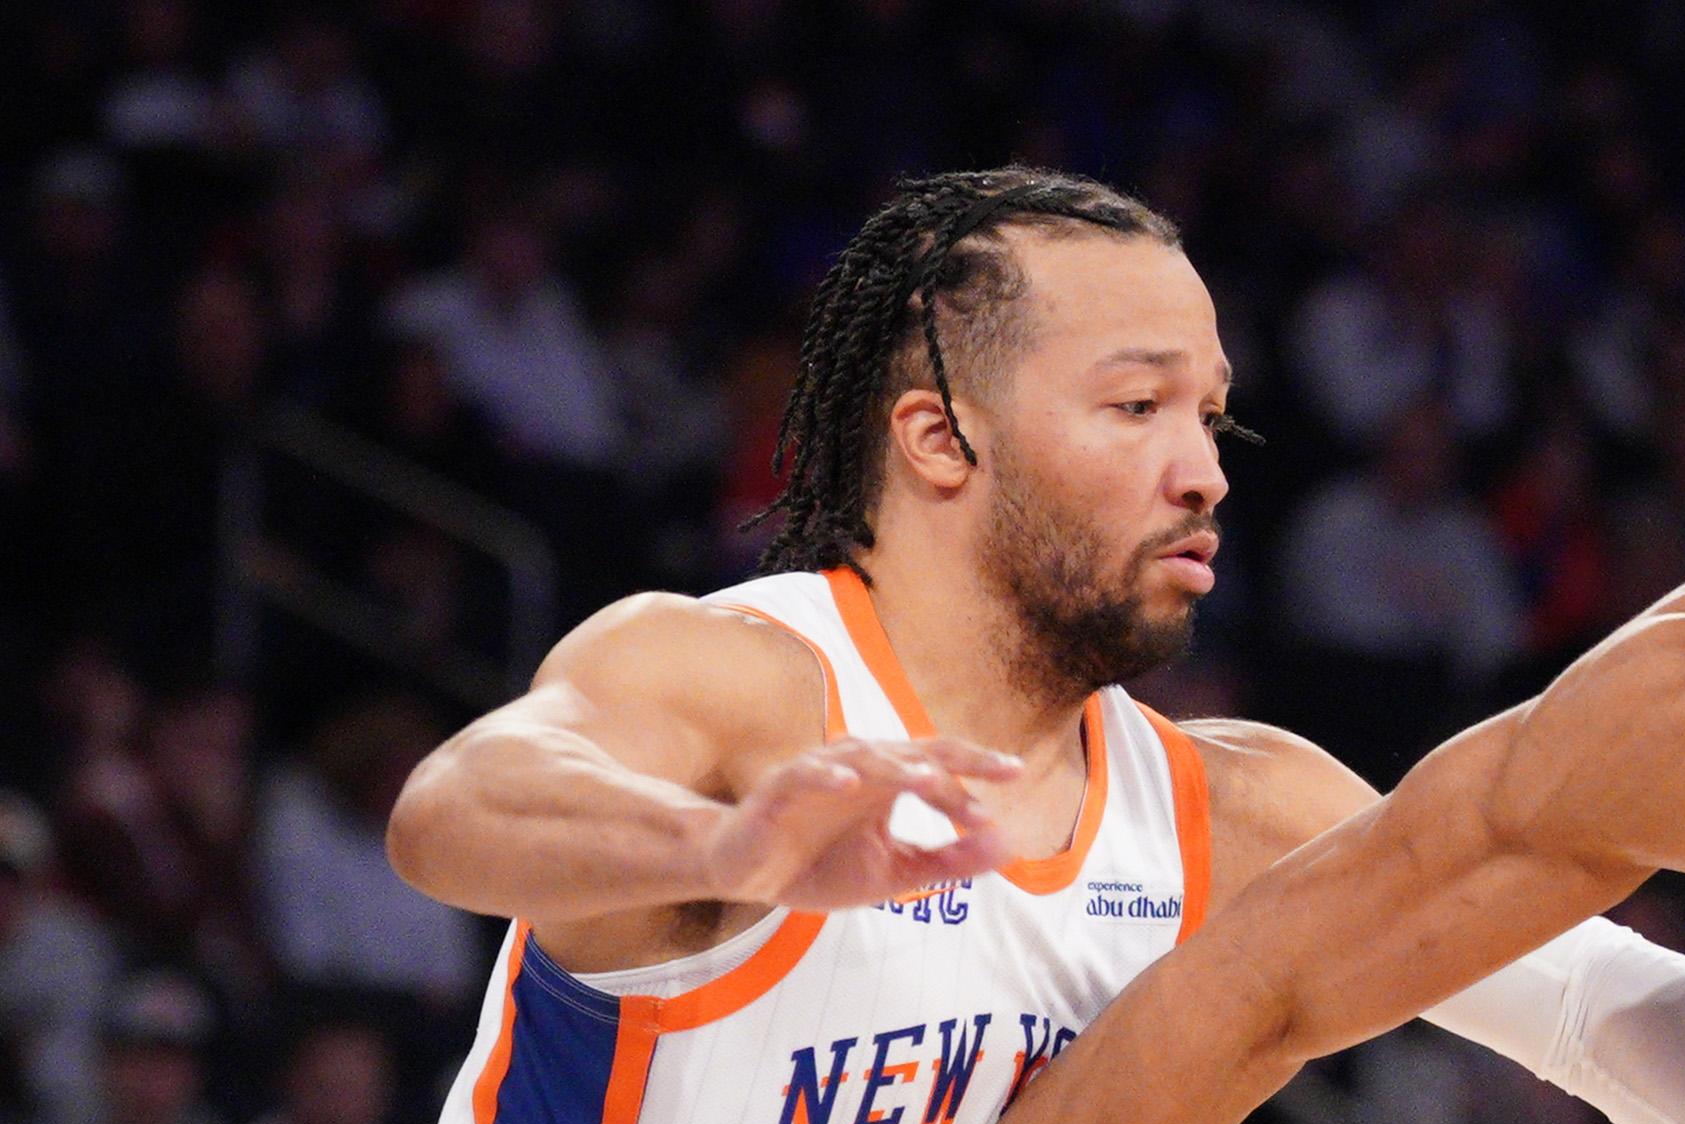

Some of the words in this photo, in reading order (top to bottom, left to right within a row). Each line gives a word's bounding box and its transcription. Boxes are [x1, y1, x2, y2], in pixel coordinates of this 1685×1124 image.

[1087, 881, 1143, 892] experience
[1086, 895, 1123, 917] abu
[1128, 895, 1182, 919] dhabi
